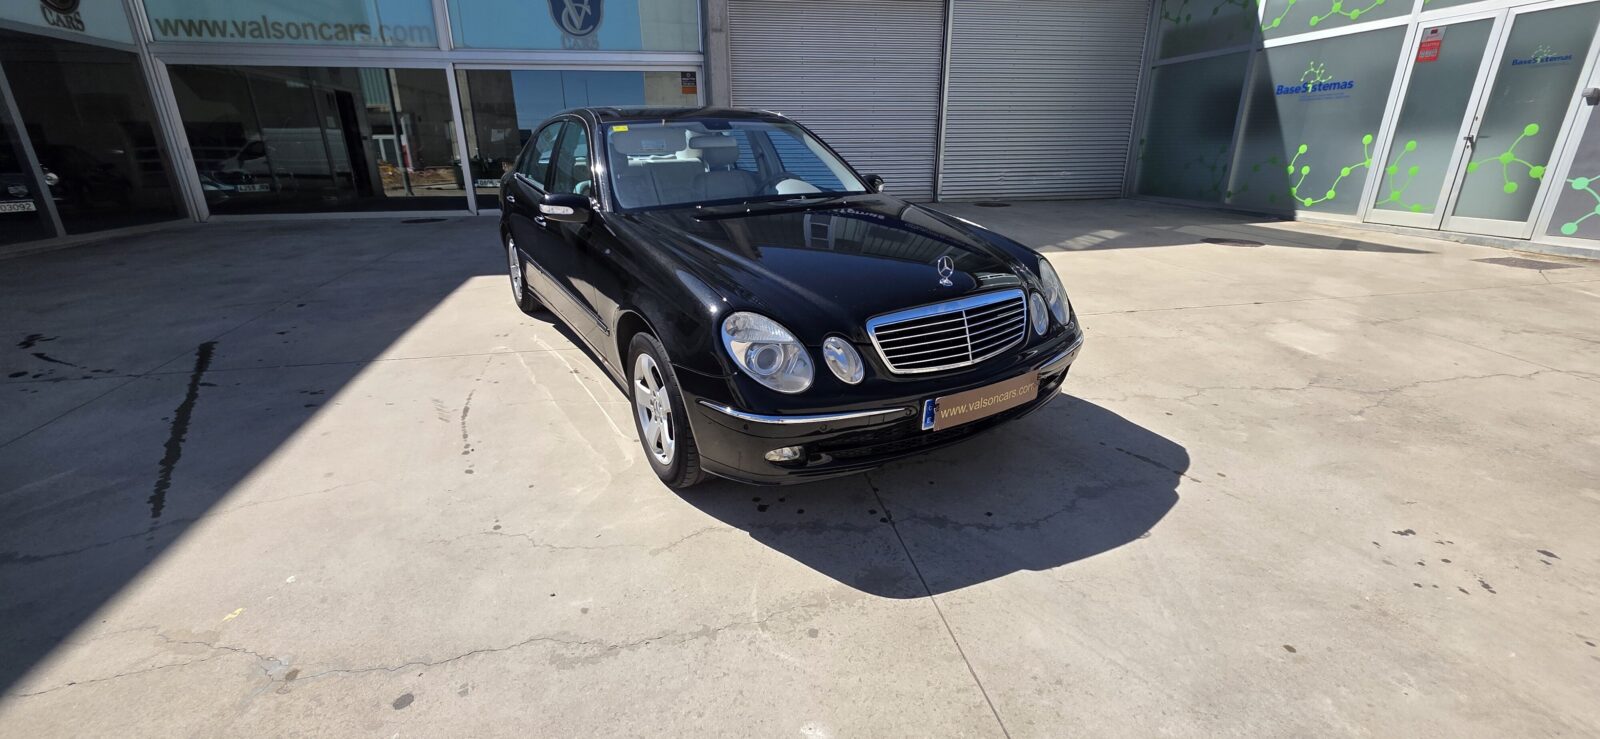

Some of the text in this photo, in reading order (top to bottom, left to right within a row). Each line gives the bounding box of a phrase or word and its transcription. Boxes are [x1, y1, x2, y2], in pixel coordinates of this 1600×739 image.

[40, 4, 85, 31] CARS
[155, 15, 432, 46] www.valsoncars.com
[1276, 80, 1354, 95] BaseSistemas
[940, 382, 1035, 419] www.valsoncars.com
